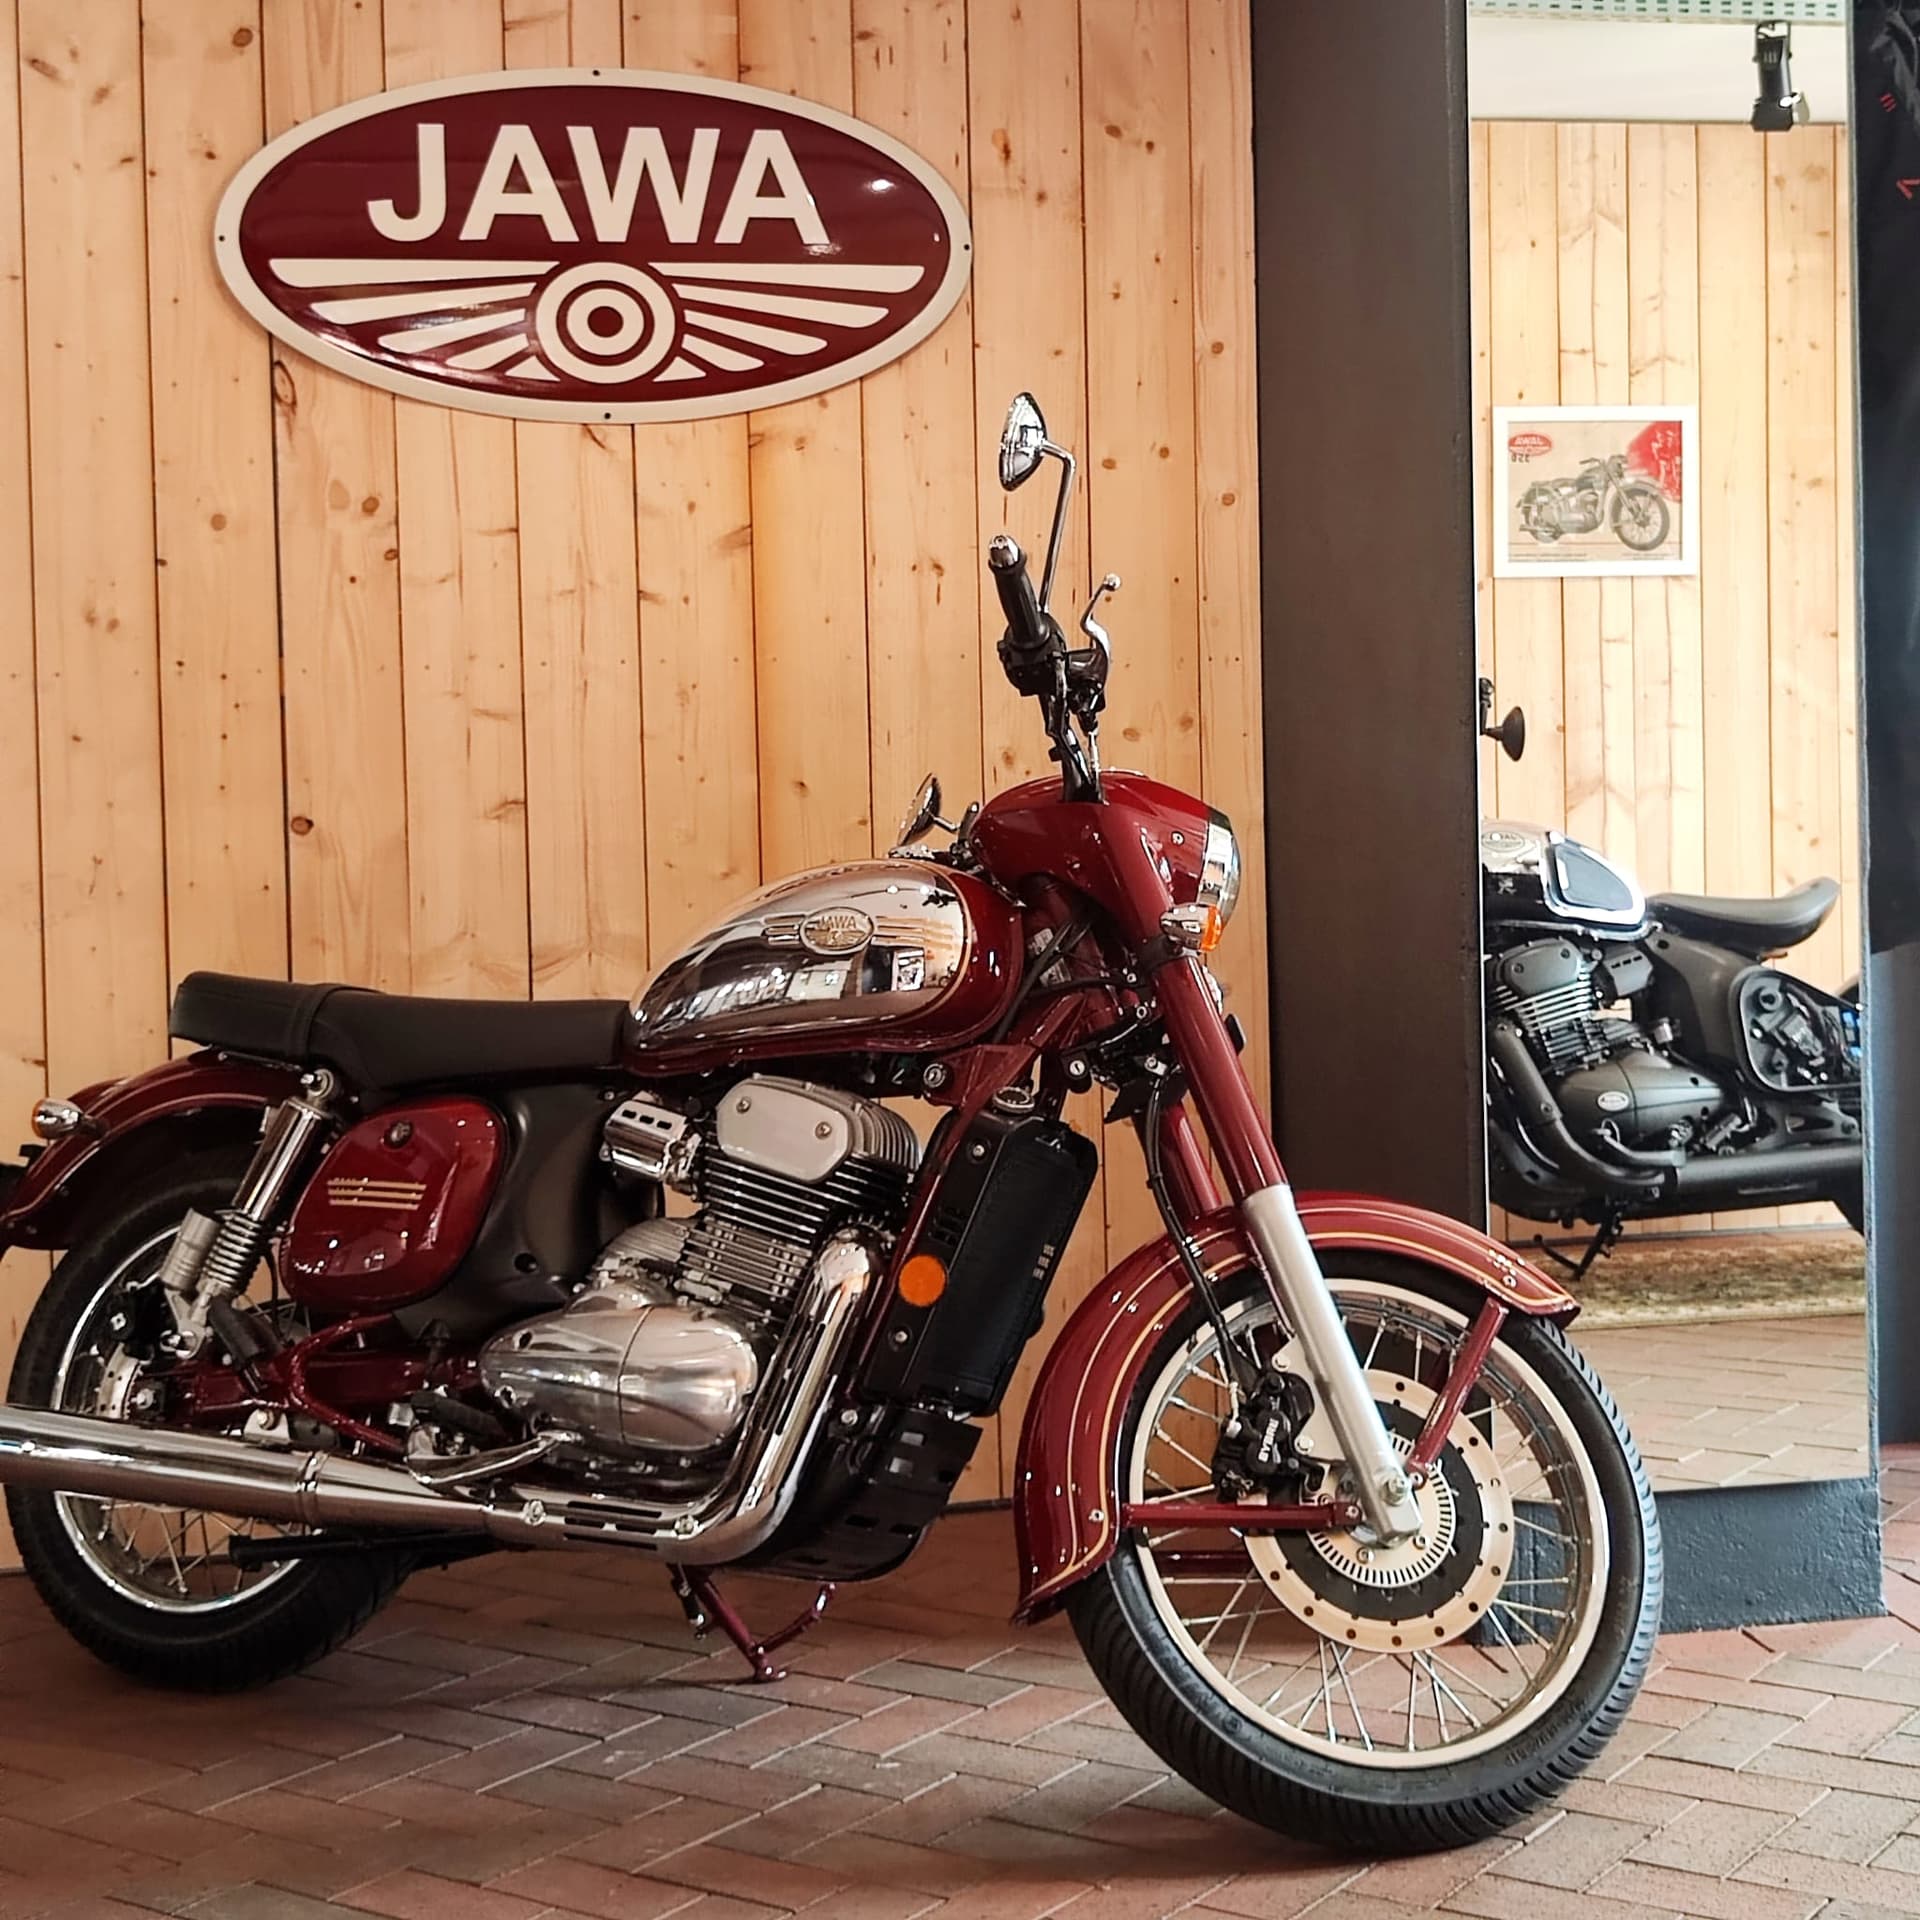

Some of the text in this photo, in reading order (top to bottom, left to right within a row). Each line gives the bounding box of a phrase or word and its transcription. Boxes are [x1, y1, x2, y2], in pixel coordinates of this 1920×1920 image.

[367, 123, 830, 245] JAWA
[816, 915, 858, 930] JAWA
[1258, 1418, 1279, 1463] BYBRE
